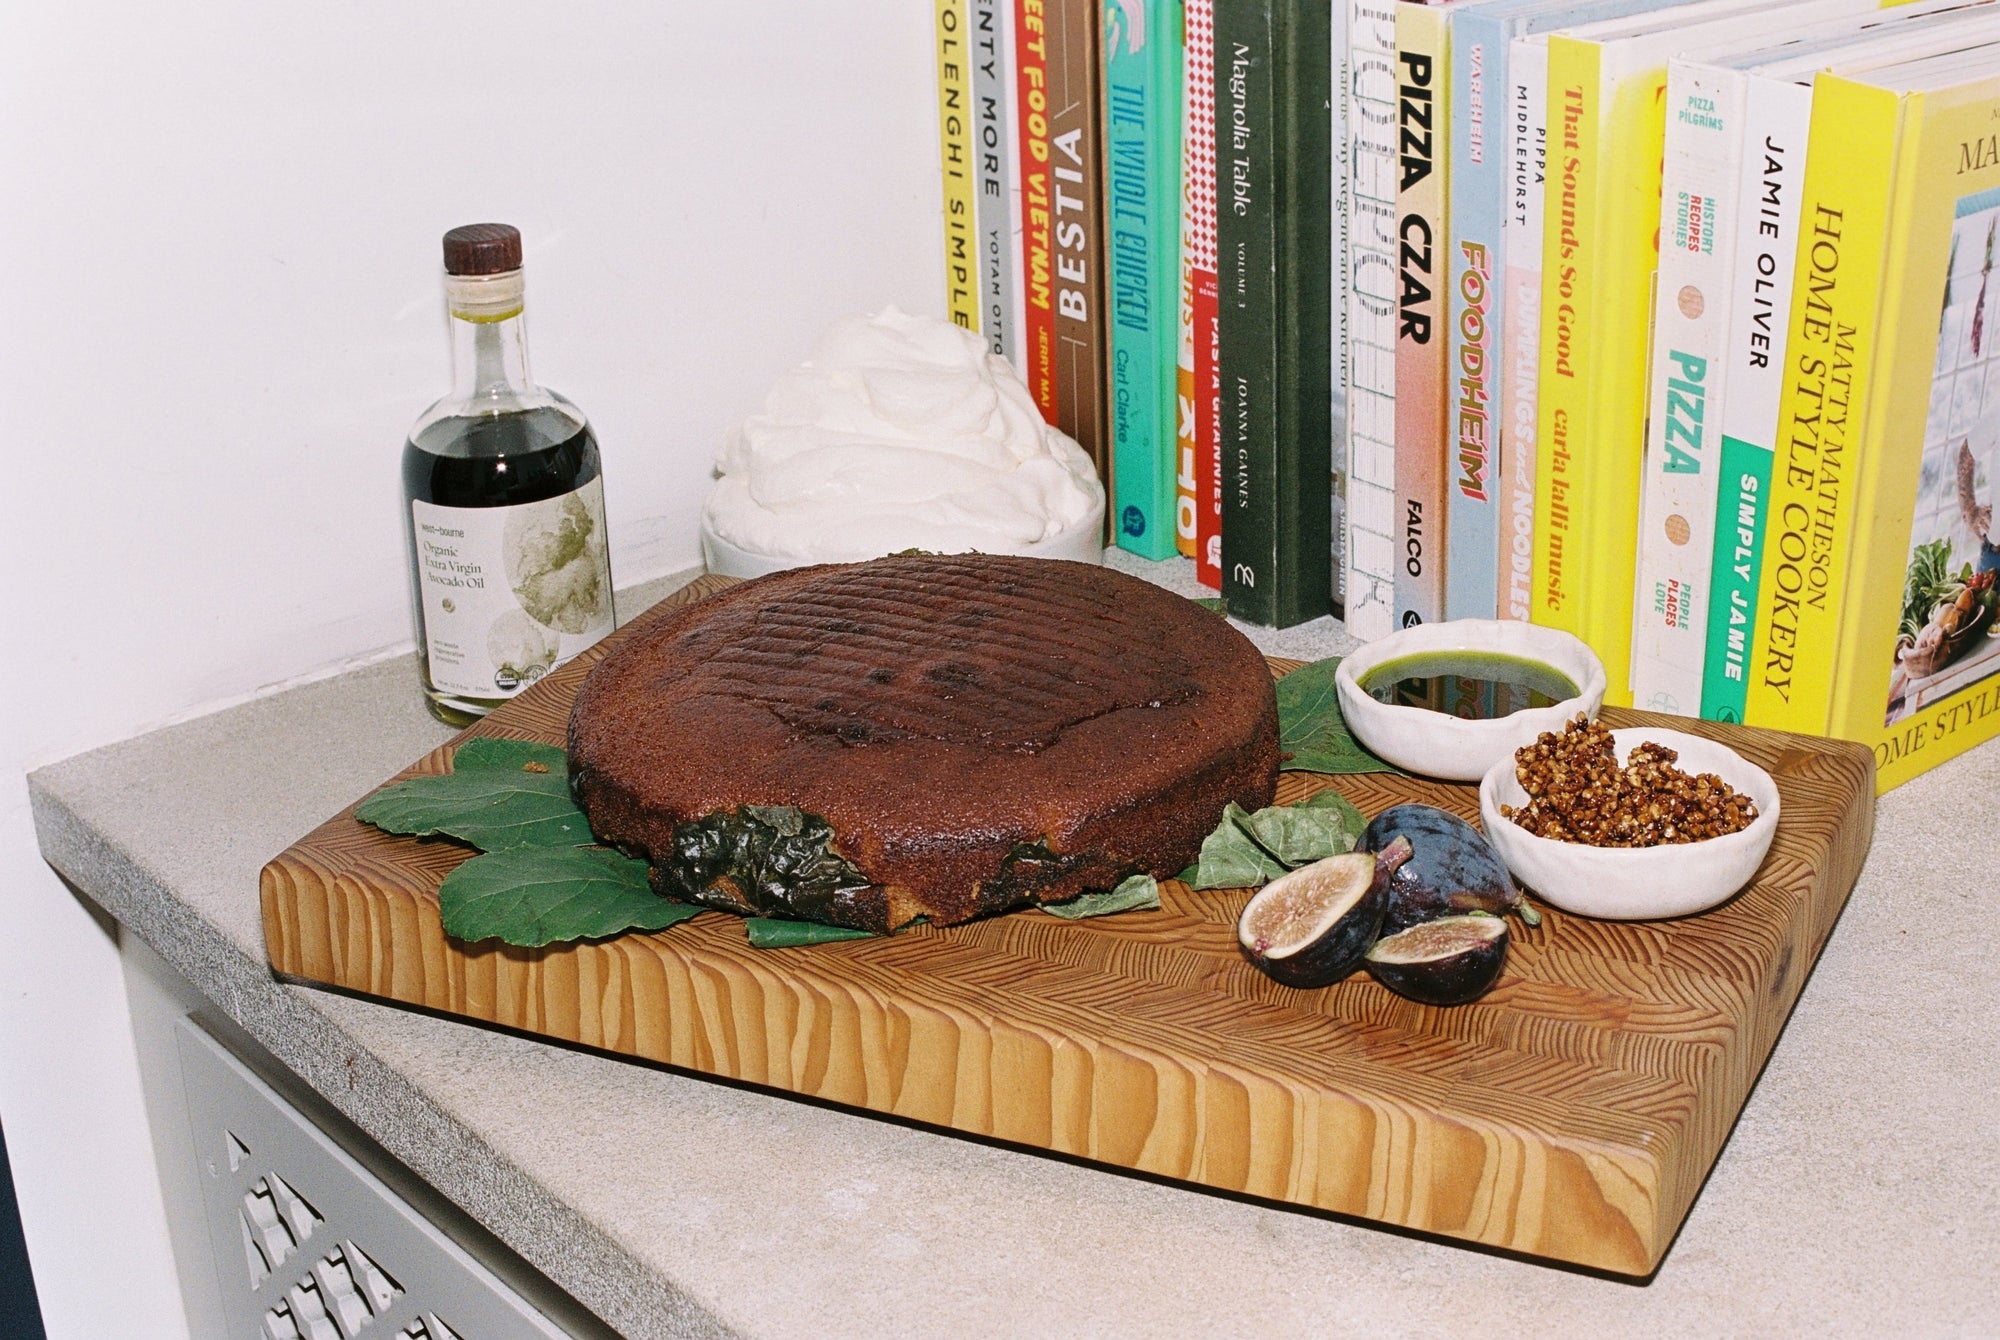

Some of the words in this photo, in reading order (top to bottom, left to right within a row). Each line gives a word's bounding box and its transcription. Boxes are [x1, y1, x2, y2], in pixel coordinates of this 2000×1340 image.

[942, 0, 963, 178] OLENGHI
[1023, 66, 1049, 163] FOOD
[1112, 84, 1145, 130] THE
[1229, 42, 1250, 150] Magnolia
[1400, 51, 1433, 193] PIZZA
[1563, 86, 1583, 151] That
[1688, 95, 1715, 113] PIZZA
[982, 97, 1000, 198] MORE
[1114, 140, 1146, 226] WHOLE
[1233, 156, 1251, 217] Table
[1515, 85, 1528, 226] MIDDLEHURST
[1535, 128, 1546, 184] PIPPA
[1053, 128, 1087, 322] BESTIA
[1560, 156, 1581, 260] Sounds
[1676, 191, 1689, 248] STORIES
[1688, 194, 1702, 253] RECIPES
[1701, 197, 1715, 256] HISTORY
[1759, 136, 1784, 239] JAMIE
[950, 198, 969, 329] SIMPLE
[989, 230, 1000, 296] YOTAM
[1028, 173, 1050, 310] VIETNAM
[1237, 242, 1246, 295] VOLUME
[1400, 213, 1433, 345] CZAR
[1803, 202, 1843, 344] HOME
[1115, 230, 1148, 332] CHICKEN
[1559, 265, 1577, 299] So
[1749, 253, 1776, 369] OLIVER
[1039, 326, 1049, 376] JERRY
[1116, 349, 1129, 386] Carl
[1211, 317, 1221, 390] PASTA
[1459, 240, 1492, 502] FOODHEIM
[1515, 286, 1537, 443] DUMPLINGS
[1556, 304, 1576, 377] Good
[1826, 321, 1857, 437] MATTY
[1040, 378, 1050, 407] MAI
[1117, 388, 1130, 443] Clarke
[1238, 377, 1248, 441] JOANNA
[1663, 349, 1707, 474] PIZZA
[1786, 354, 1827, 492] STYLE
[1212, 397, 1222, 516] GRANNIES
[1238, 448, 1248, 509] GAINES
[1553, 408, 1571, 473] carla
[1407, 499, 1422, 578] FALCO
[1550, 478, 1570, 531] lalli
[1734, 473, 1758, 583] SIMPLY
[1807, 438, 1844, 611] MATHESON
[423, 541, 459, 557] Organic
[425, 555, 447, 571] Extra
[448, 561, 481, 576] Virgin
[428, 572, 465, 588] Avocado
[466, 577, 485, 588] Oil
[1510, 489, 1533, 623] NOODLES
[1547, 533, 1566, 611] music
[1655, 581, 1666, 614] LOVE
[1665, 578, 1679, 628] PLACES
[1677, 583, 1691, 630] PEOPLE
[1725, 589, 1748, 681] JAMIE
[1764, 502, 1810, 703] COOKERY
[1873, 722, 1928, 771] OME
